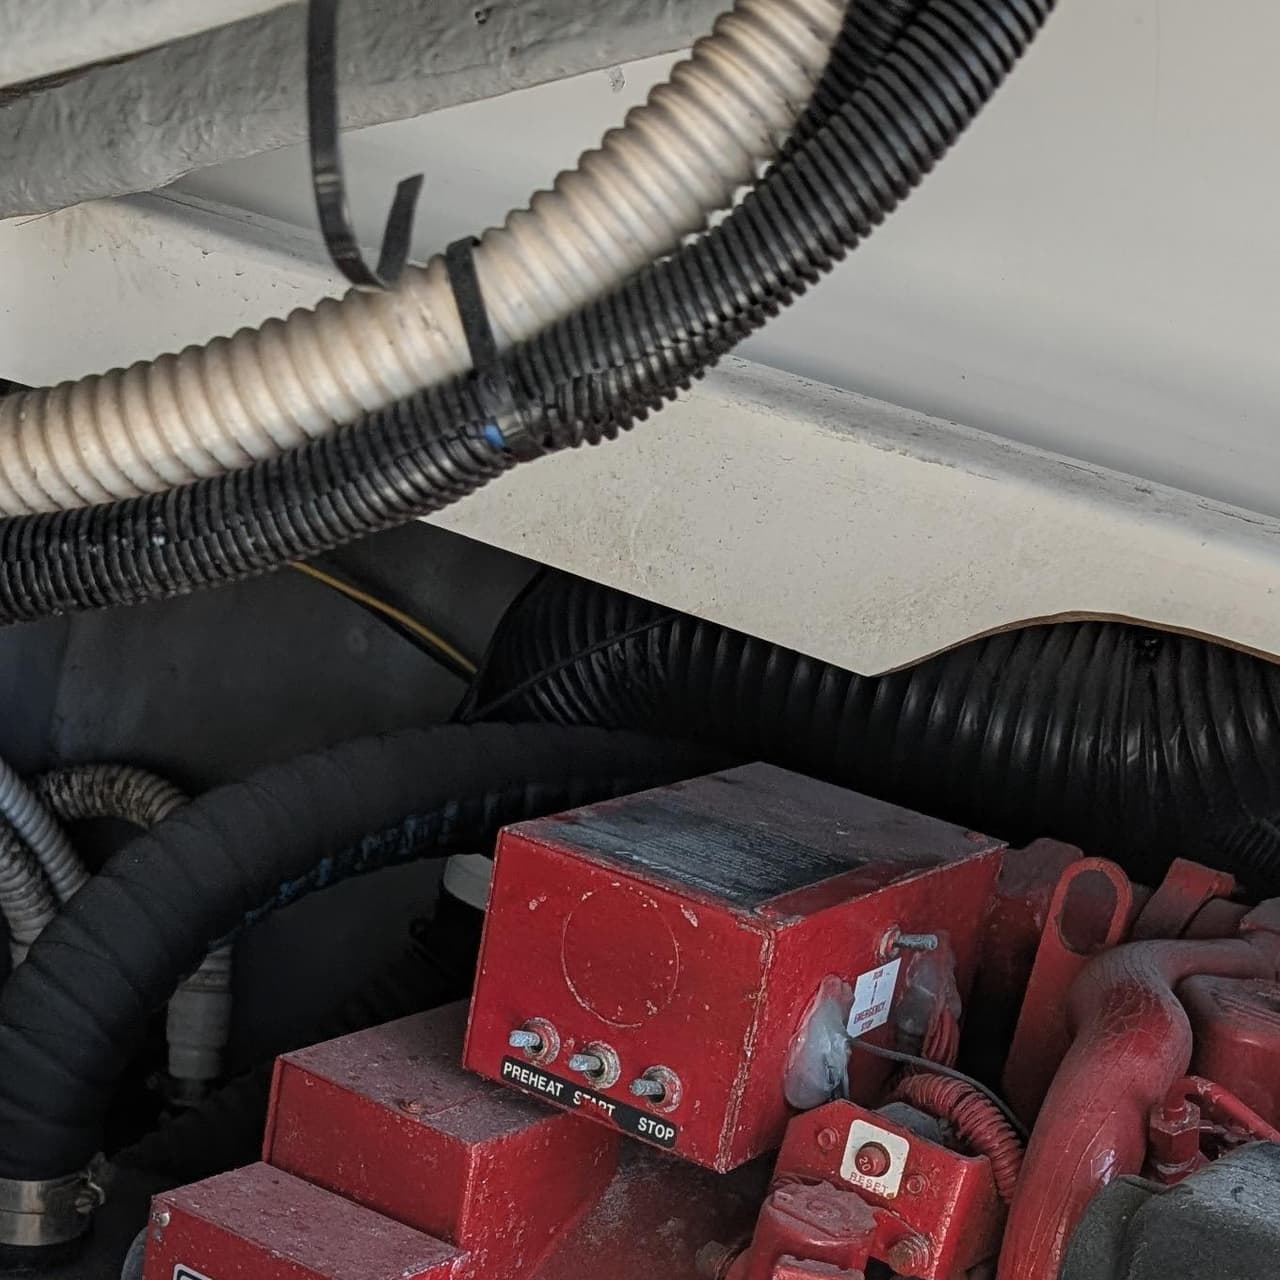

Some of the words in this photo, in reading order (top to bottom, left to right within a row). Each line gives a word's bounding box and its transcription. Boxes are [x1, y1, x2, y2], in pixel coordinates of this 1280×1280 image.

[503, 1062, 564, 1097] PREHEAT
[637, 1117, 675, 1141] STOP
[849, 1171, 889, 1194] RESET
